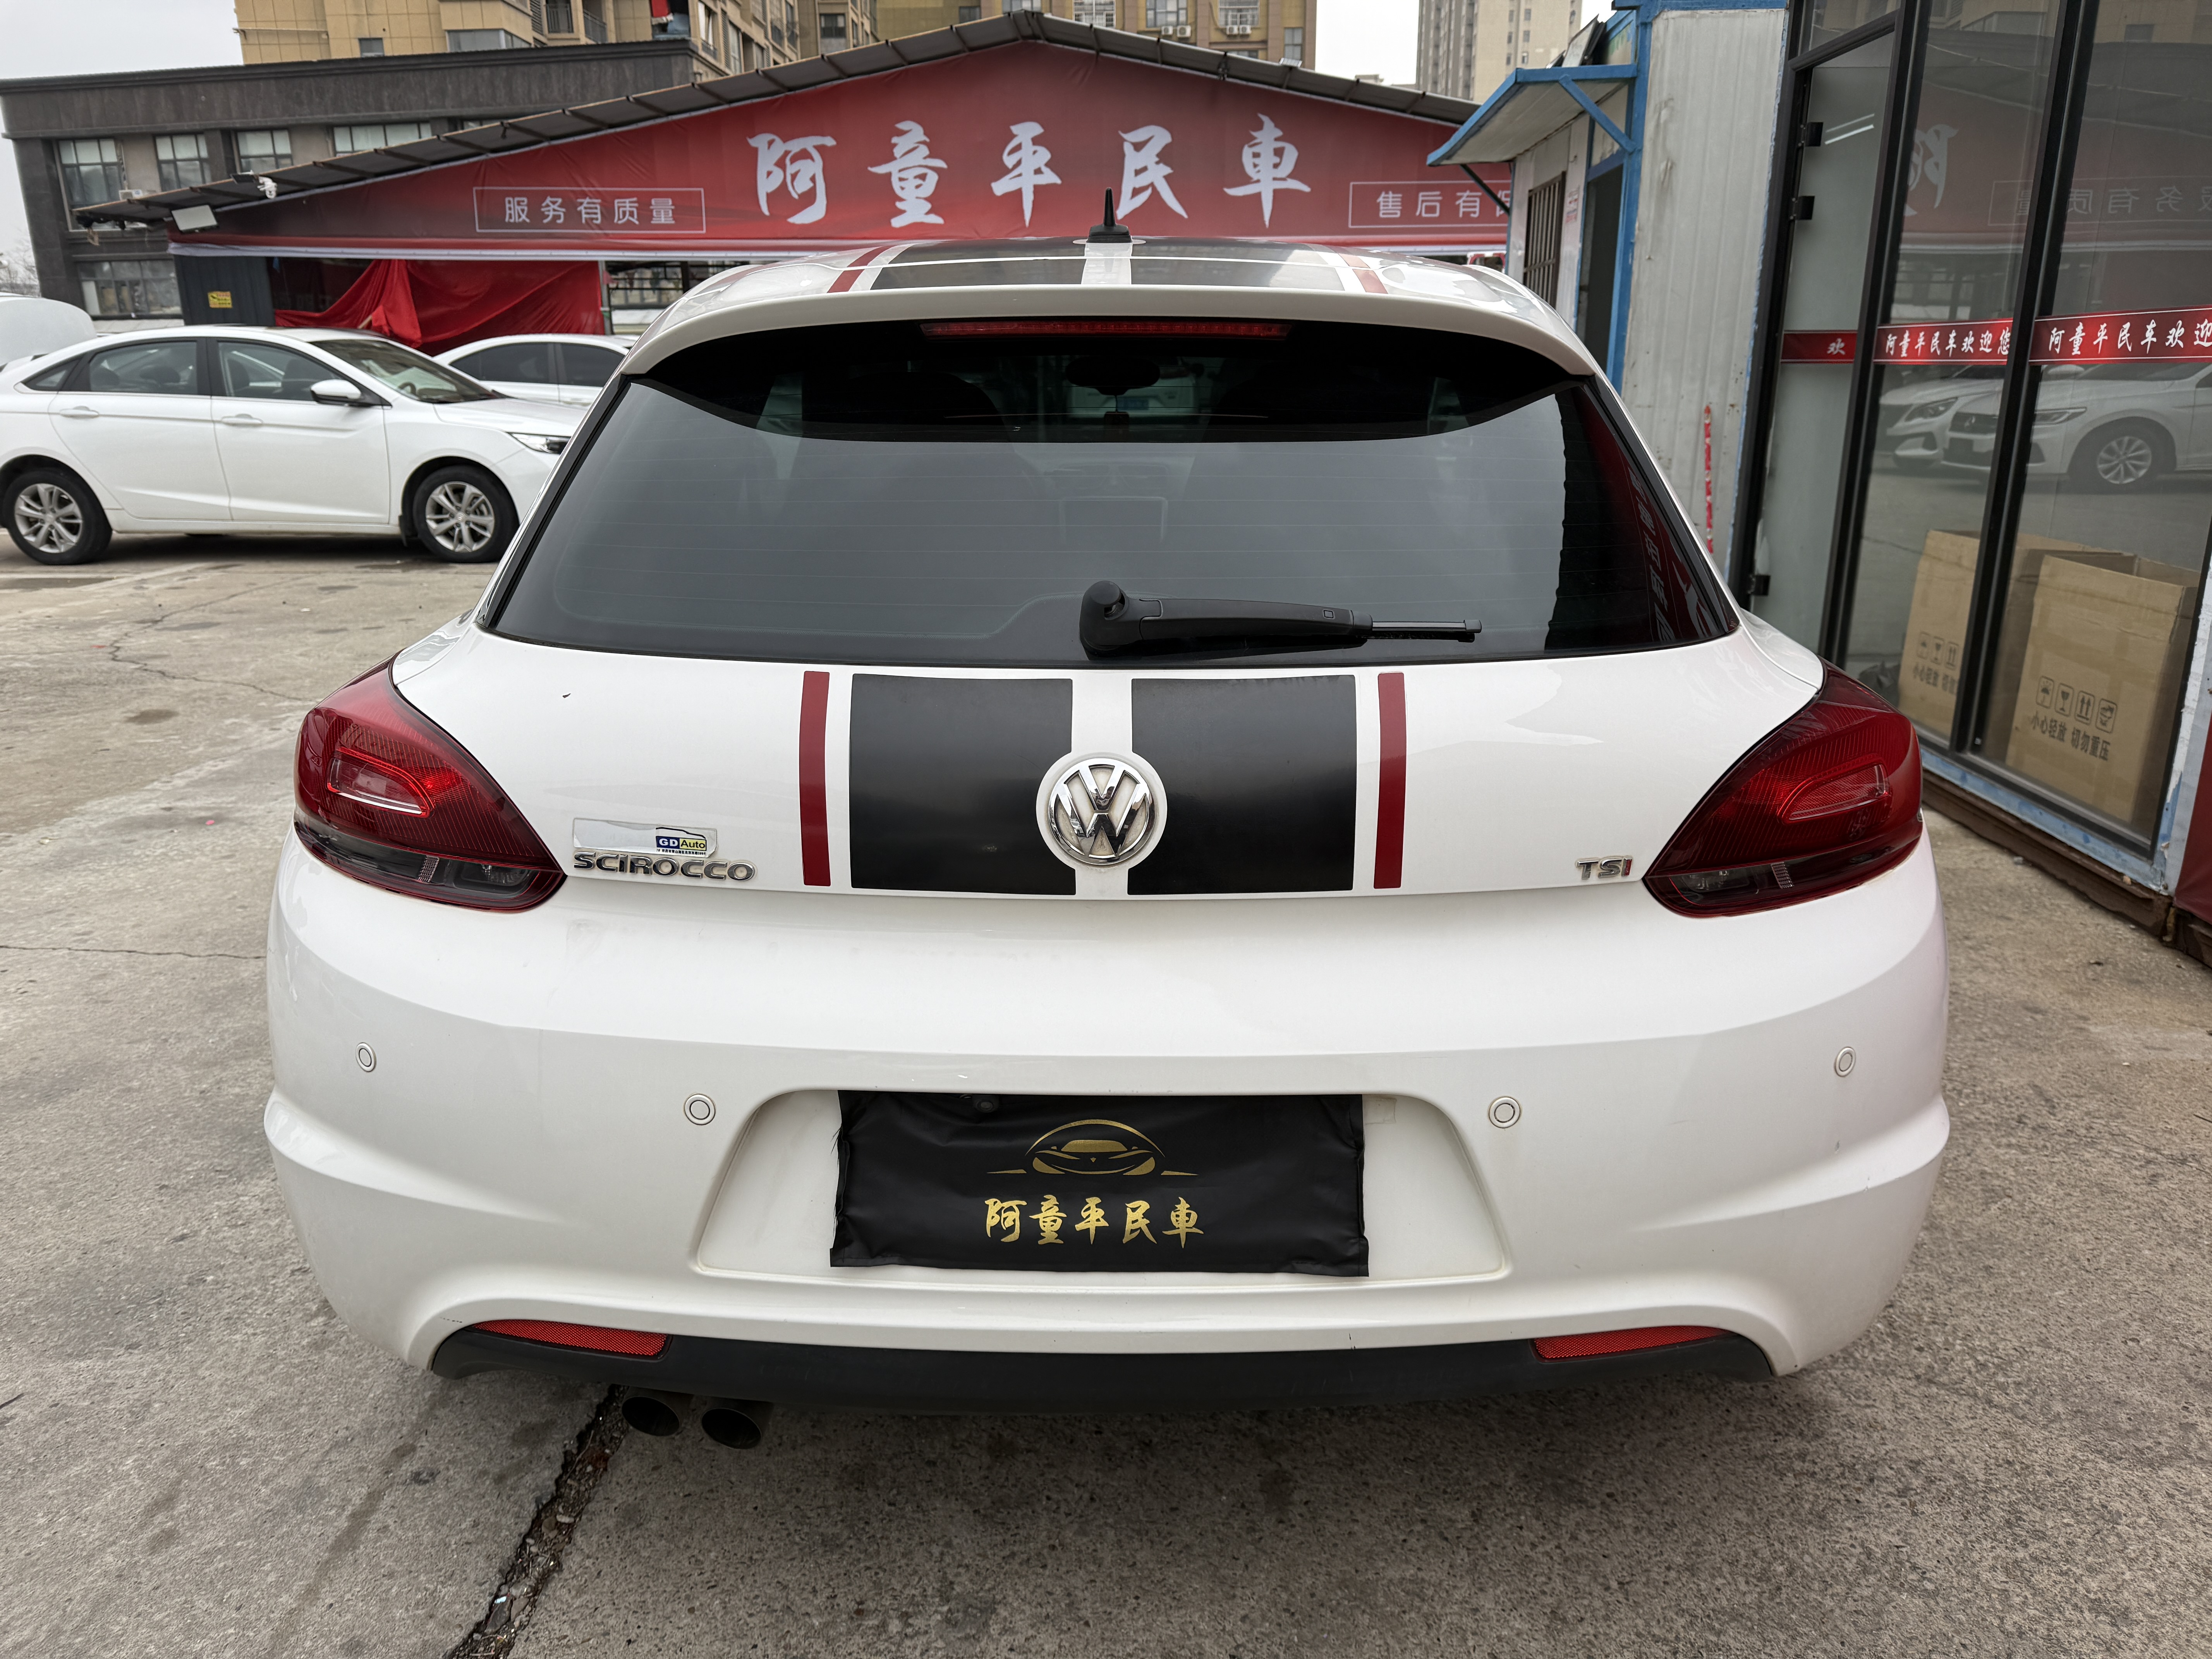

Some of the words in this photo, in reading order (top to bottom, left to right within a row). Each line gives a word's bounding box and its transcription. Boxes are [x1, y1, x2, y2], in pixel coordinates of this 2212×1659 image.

[746, 113, 1311, 228] 阿童平民車
[505, 196, 675, 225] 服务有质量
[2031, 710, 2067, 742] 小心轻放
[574, 852, 756, 882] SCIROCCO
[1577, 858, 1633, 880] TSI
[985, 1195, 1204, 1249] 阿童平民車
